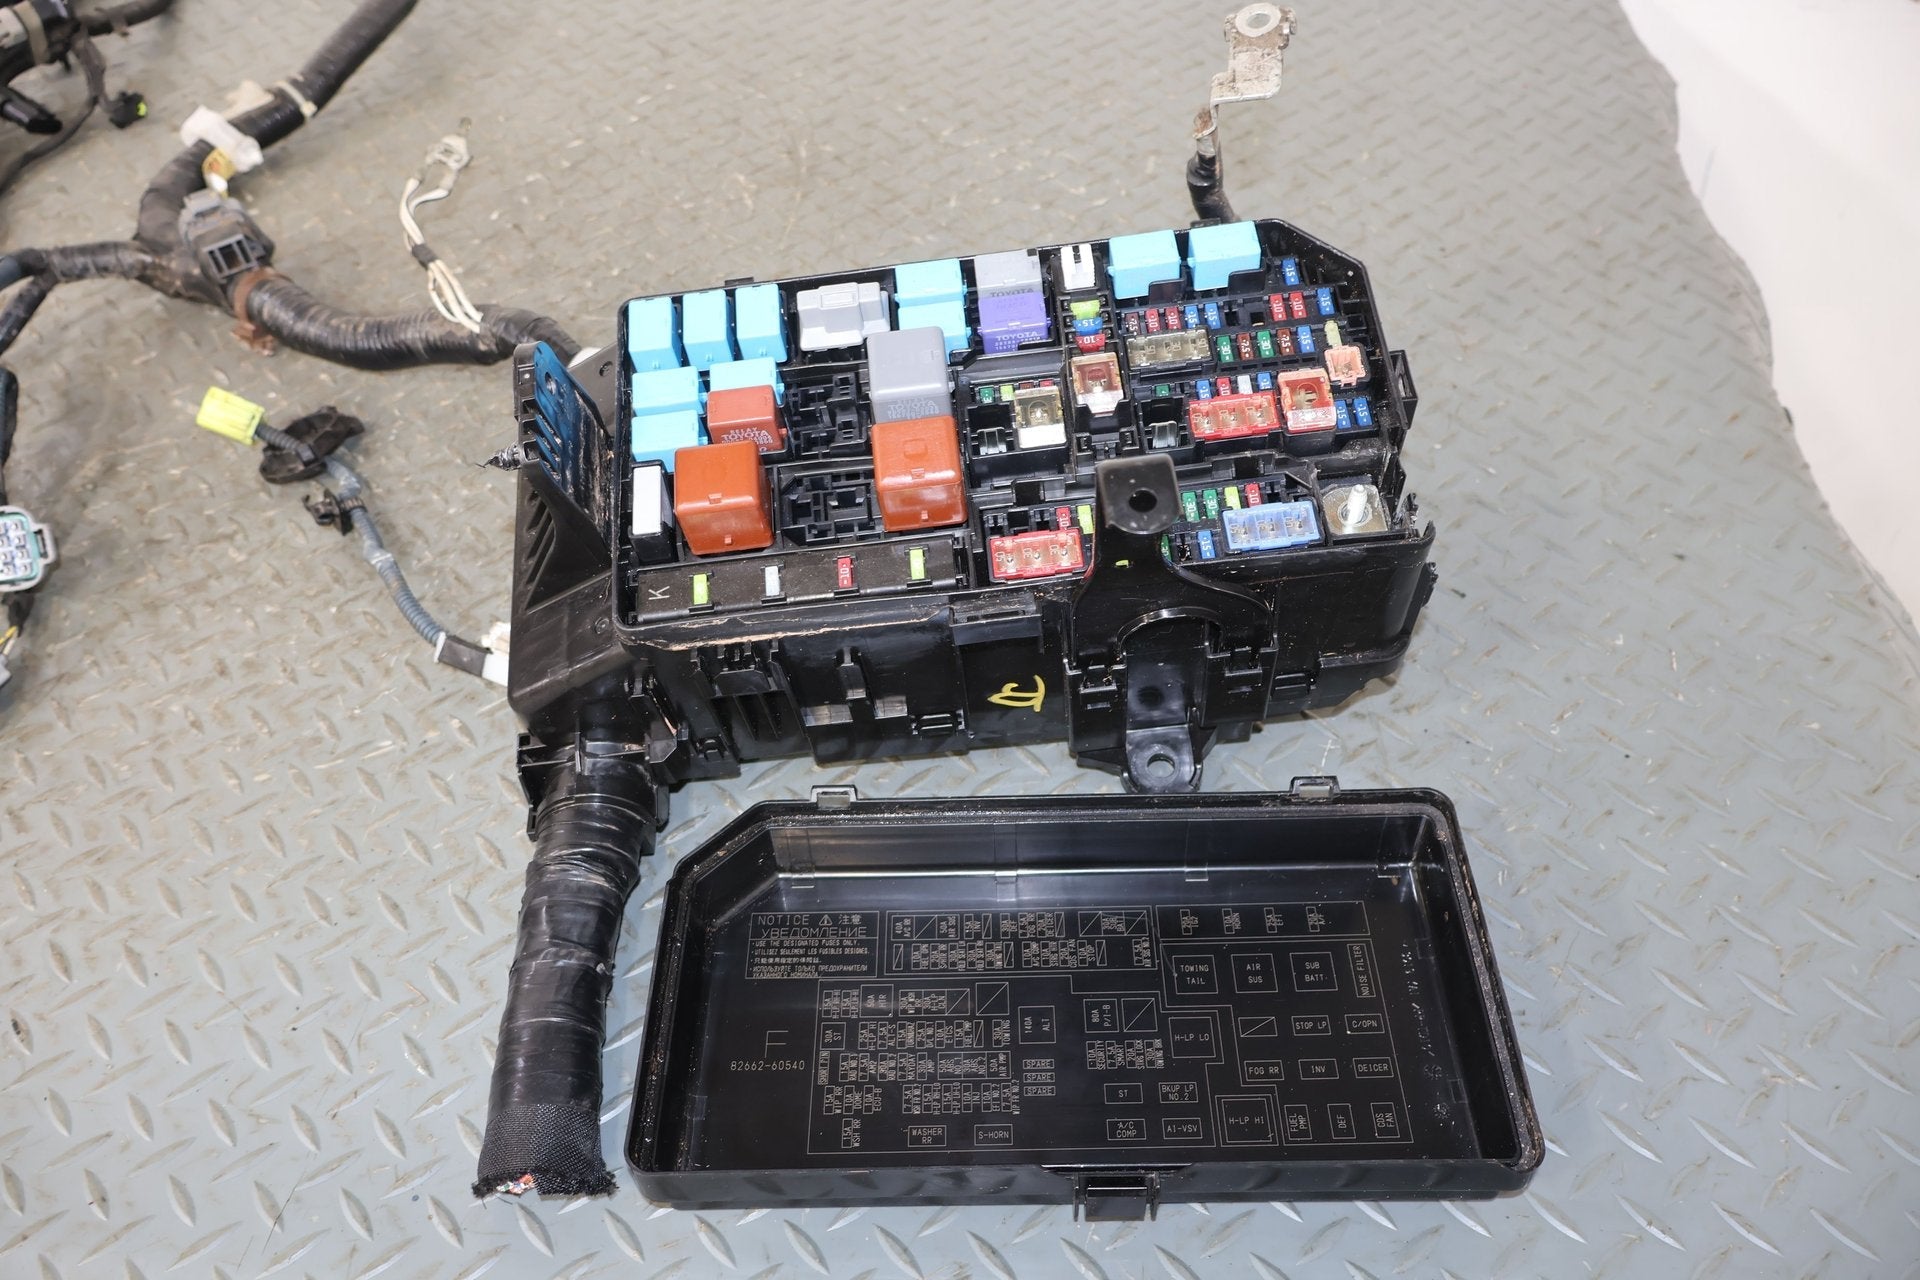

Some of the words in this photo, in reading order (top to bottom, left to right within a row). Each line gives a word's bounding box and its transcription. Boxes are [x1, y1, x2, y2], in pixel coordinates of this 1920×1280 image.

[995, 331, 1039, 341] TOYOTA
[1083, 336, 1096, 344] 10
[840, 567, 850, 578] 10
[648, 585, 671, 600] K
[757, 914, 810, 926] NOTICE
[838, 914, 862, 925] 注意
[761, 926, 867, 938] УВЕДОМЛЕНИЕ
[1352, 945, 1365, 971] FILTER
[1180, 964, 1209, 972] TOWING
[1246, 963, 1261, 971] AIR
[1305, 961, 1320, 970] SUB
[1186, 977, 1205, 985] TAIL
[1358, 975, 1370, 996] NOISE
[878, 994, 887, 1008] HTR
[1091, 1009, 1100, 1023] 80A
[1102, 1004, 1112, 1027] P/I-B
[1024, 1016, 1033, 1034] 140A
[1041, 1018, 1050, 1031] ALT
[1295, 1021, 1314, 1030] STOP
[1318, 1020, 1327, 1029] LP
[1352, 1020, 1378, 1028] C/OPN
[824, 1029, 833, 1043] 30A
[834, 1032, 842, 1041] ST
[888, 1024, 896, 1046] ALT-S
[945, 1025, 954, 1043] ETCS
[1002, 1020, 1011, 1046] TOWING
[1174, 1033, 1195, 1041] H-LP
[1199, 1033, 1210, 1041] LO
[868, 1035, 877, 1051] H-LP
[1116, 1044, 1125, 1066] SMART
[730, 1060, 805, 1071] 82662-60540
[869, 1061, 877, 1074] AM2
[907, 1053, 916, 1080] MAYDAY
[989, 1058, 998, 1072] 50A
[1025, 1060, 1051, 1068] SPARE
[1311, 1065, 1327, 1073] INV
[1357, 1064, 1389, 1072] DEICER
[1026, 1073, 1052, 1081] SPARE
[1249, 1067, 1265, 1075] FOG
[1027, 1087, 1052, 1095] SPARE
[1118, 1090, 1129, 1098] ST
[1161, 1085, 1181, 1093] BKUP
[825, 1094, 833, 1107] 15A
[845, 1093, 853, 1106] 10A
[865, 1093, 873, 1106] 10A
[873, 1088, 882, 1111] ECU-B
[963, 1092, 972, 1105] 10A
[983, 1091, 991, 1104] 10A
[1168, 1092, 1189, 1101] NO.2
[1118, 1121, 1134, 1129] A/C
[1228, 1116, 1249, 1124] H-LP
[1290, 1112, 1298, 1132] FUEL
[1299, 1115, 1308, 1130] PMP
[1337, 1114, 1347, 1129] DEF
[1376, 1112, 1386, 1128] CDS
[1385, 1112, 1395, 1127] FAN
[844, 1127, 852, 1140] 15A
[912, 1128, 943, 1136] WASHER
[978, 1131, 1009, 1139] S-HORN
[1116, 1130, 1137, 1138] COMP
[921, 1136, 932, 1144] RR
